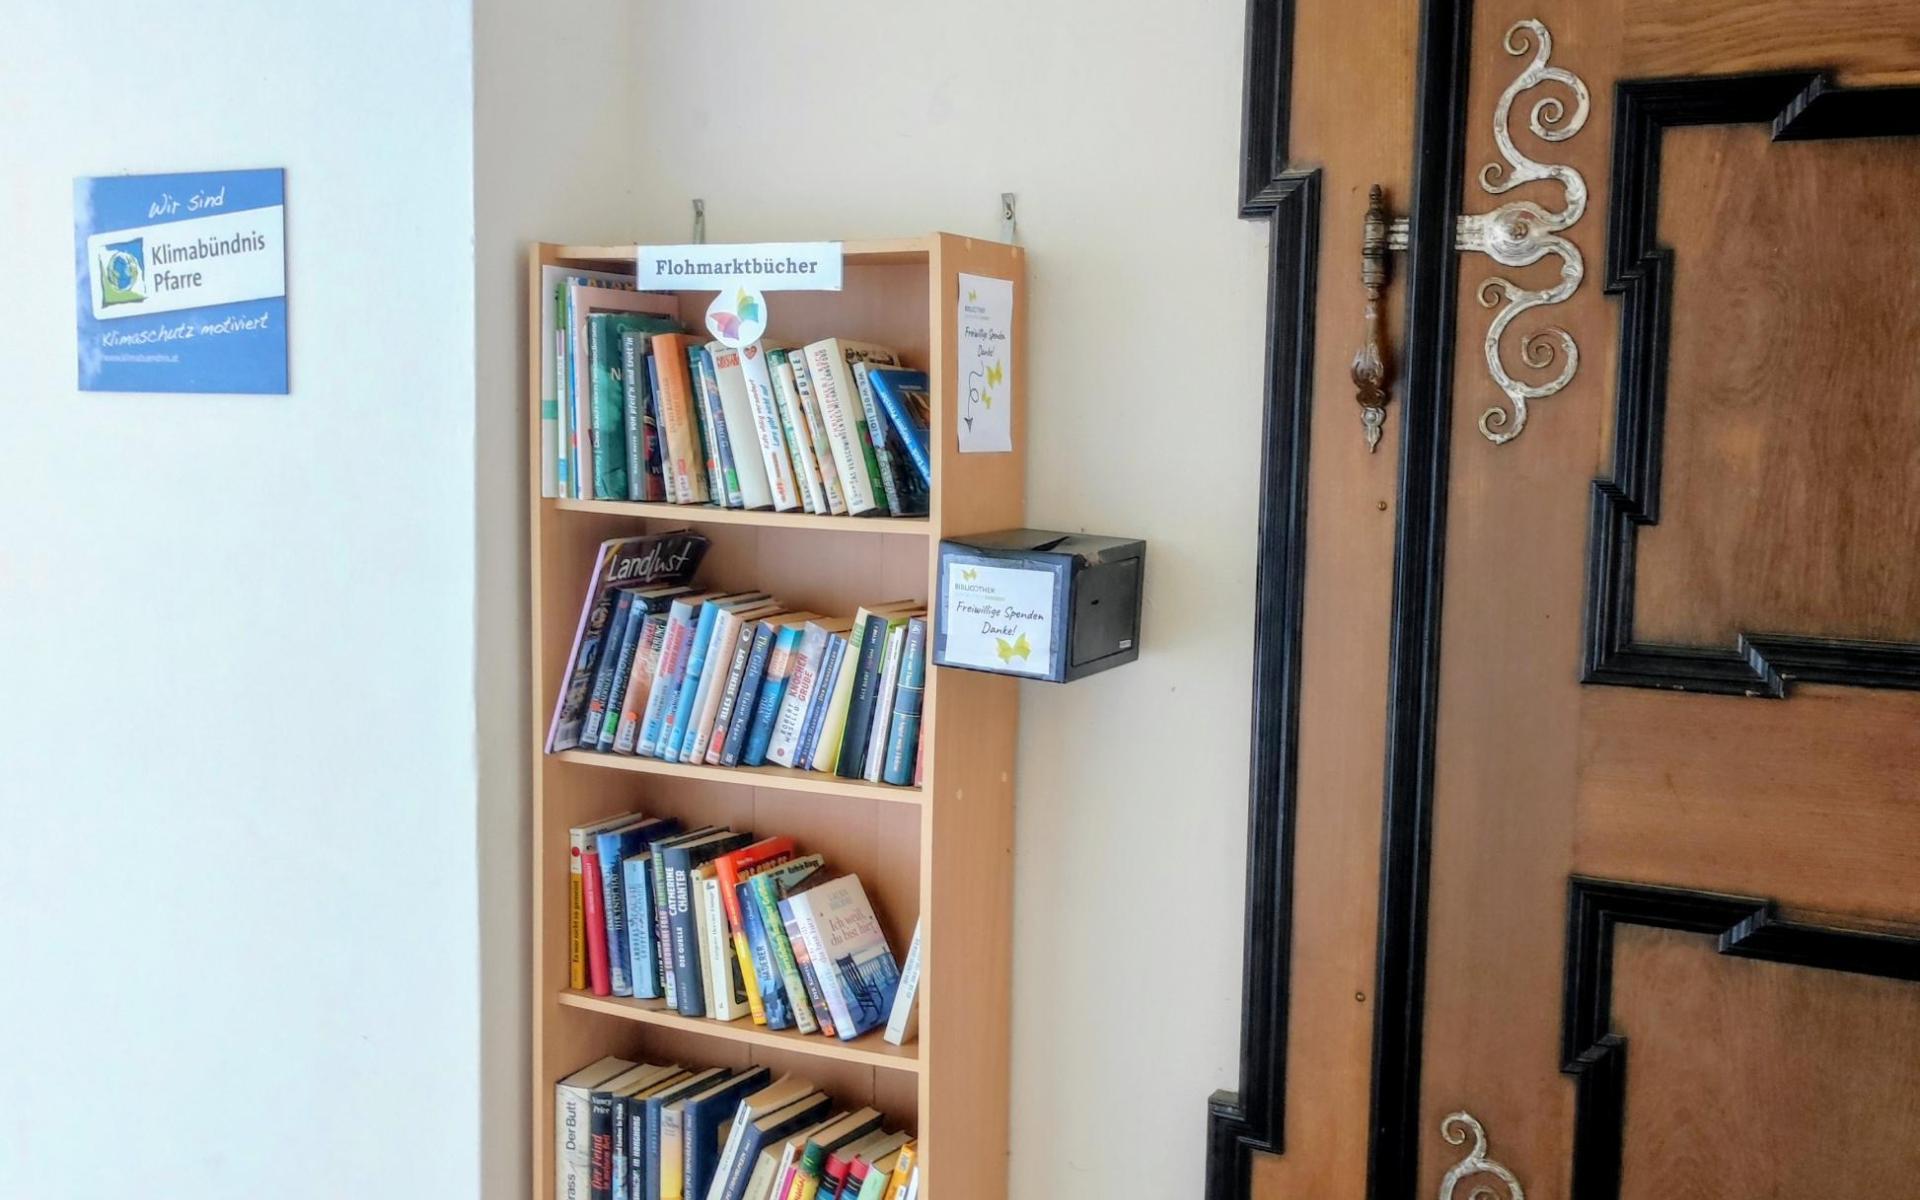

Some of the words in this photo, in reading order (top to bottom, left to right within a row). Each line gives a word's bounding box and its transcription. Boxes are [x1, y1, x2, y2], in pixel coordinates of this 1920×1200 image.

[148, 194, 180, 218] Wir
[188, 186, 225, 212] sind
[152, 230, 266, 266] Klimabündnis
[154, 271, 202, 292] Pfarre
[655, 257, 818, 276] Flohmarktbücher
[102, 322, 196, 347] Klimaschutz
[200, 312, 269, 334] motiviert
[791, 357, 811, 396] BULLE
[608, 541, 692, 583] Landlust
[956, 600, 1001, 618] Freiwillige
[1004, 606, 1044, 620] Spenden
[754, 634, 768, 653] The
[981, 621, 1018, 636] Danke!
[747, 653, 762, 678] Girls
[788, 652, 808, 698] KNOCHEN
[719, 696, 732, 720] ALLES
[726, 671, 739, 695] STEHT
[733, 648, 746, 670] KOPF
[797, 670, 813, 701] GRUBE
[779, 702, 793, 735] ROBERT
[666, 866, 677, 916] CATHERINE
[675, 870, 688, 912] CHANTER
[754, 944, 772, 981] HADERER
[565, 1101, 576, 1126] Butt
[565, 1127, 576, 1150] Der
[591, 1133, 601, 1166] Feind
[567, 1173, 576, 1199] rass
[591, 1168, 601, 1189] Der
